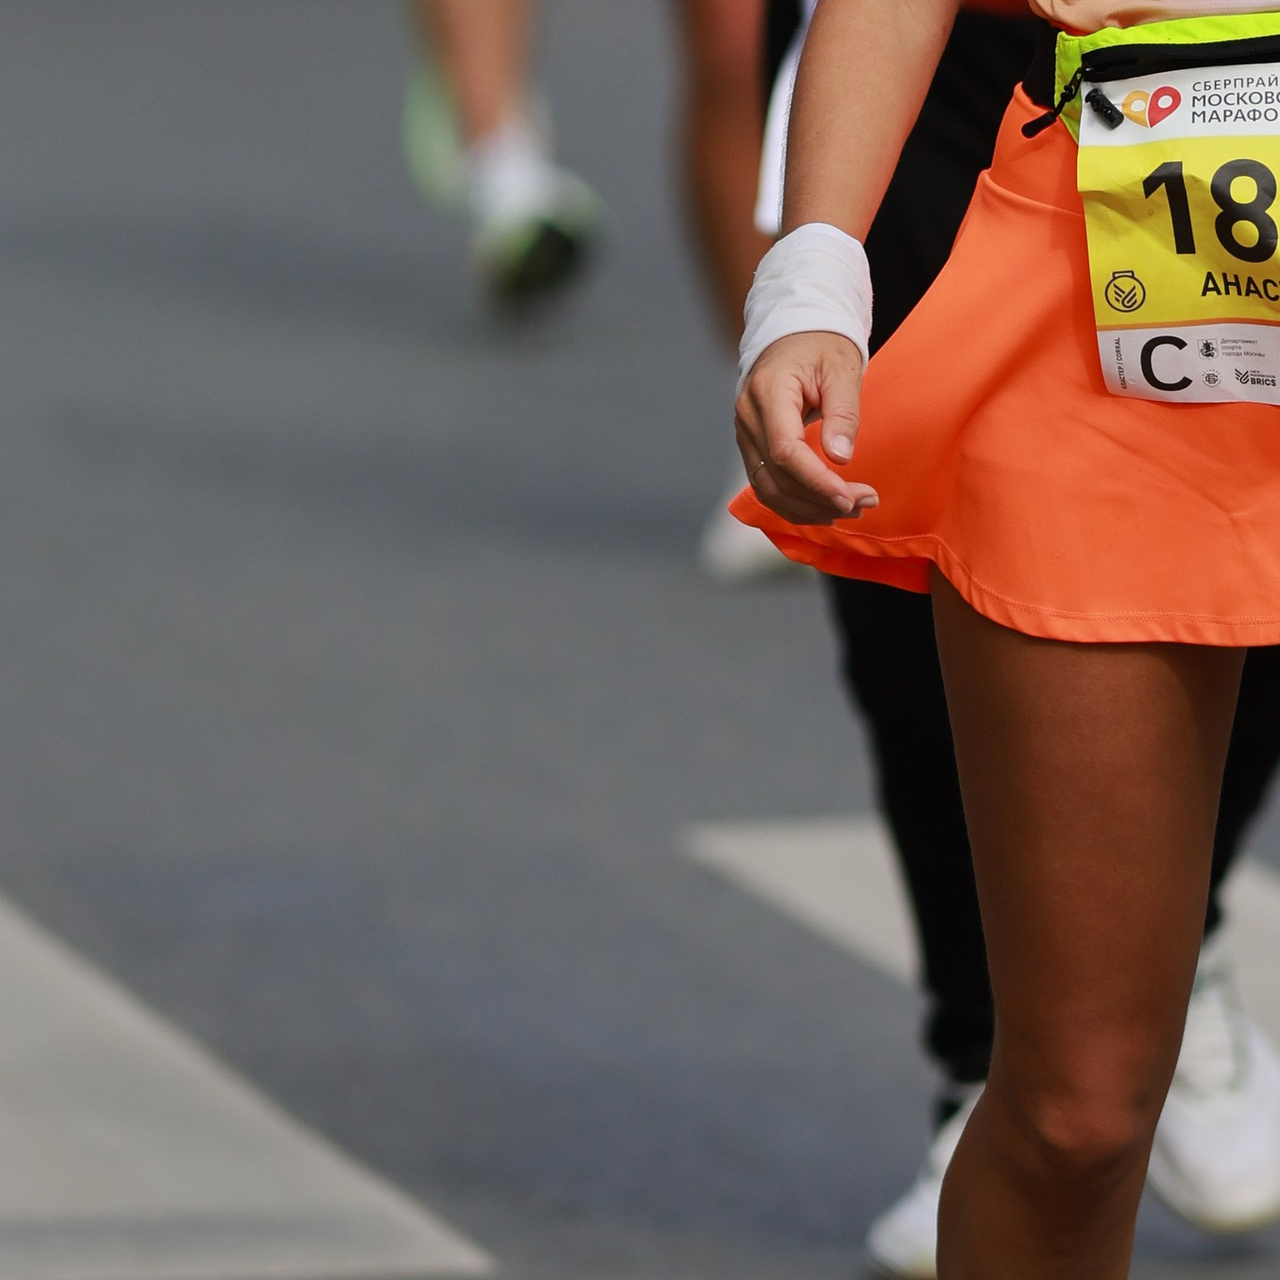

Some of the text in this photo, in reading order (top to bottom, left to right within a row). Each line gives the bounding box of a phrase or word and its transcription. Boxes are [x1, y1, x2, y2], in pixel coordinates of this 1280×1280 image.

[1114, 337, 1123, 361] CORRAL
[1140, 335, 1193, 392] C
[1250, 377, 1277, 387] BRICS
